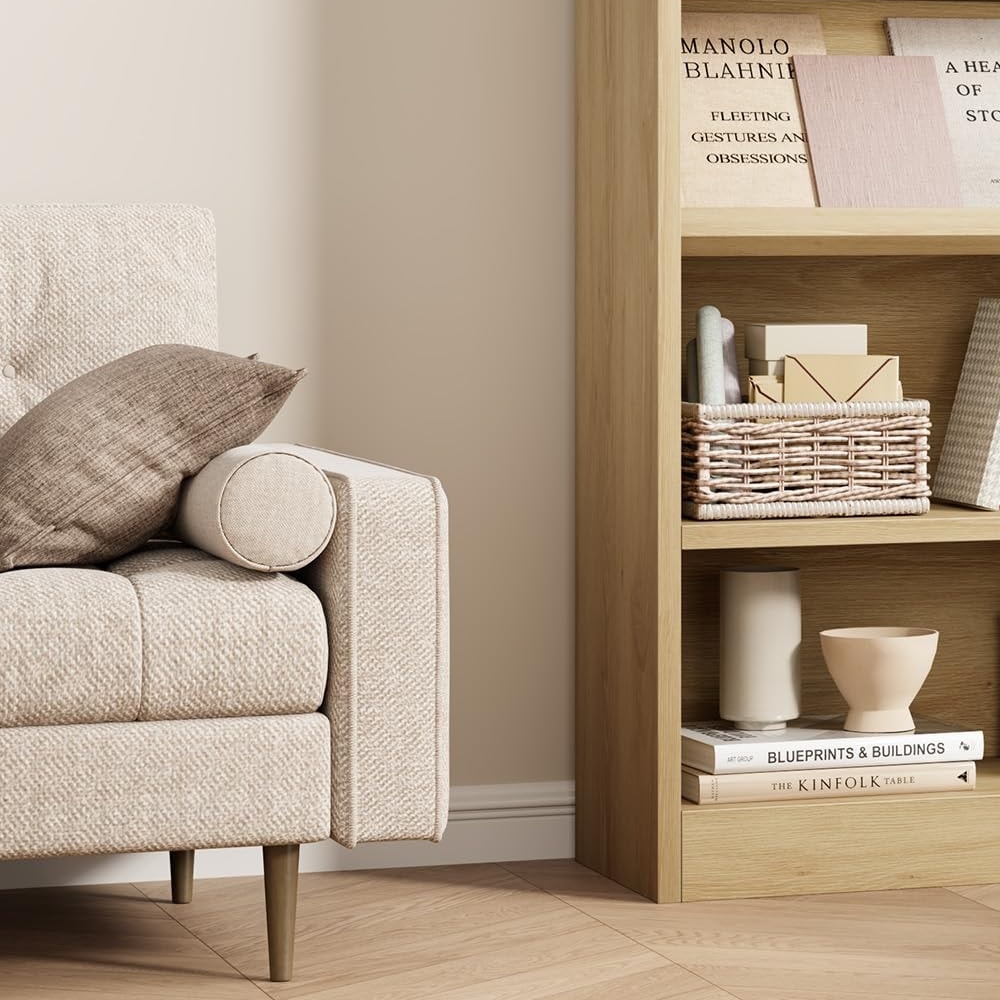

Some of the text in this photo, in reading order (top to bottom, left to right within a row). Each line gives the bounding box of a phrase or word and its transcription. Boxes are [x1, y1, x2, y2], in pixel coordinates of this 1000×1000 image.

[681, 38, 789, 55] MANOLO
[945, 61, 958, 73] A
[956, 84, 982, 96] OF
[711, 111, 791, 121] FLEETING
[691, 132, 777, 143] GESTURES
[706, 153, 808, 164] OBSESSIONS
[767, 742, 946, 763] BLUEPRINTS & BUILDINGS
[771, 775, 915, 792] THE KINFOLK TABLE
